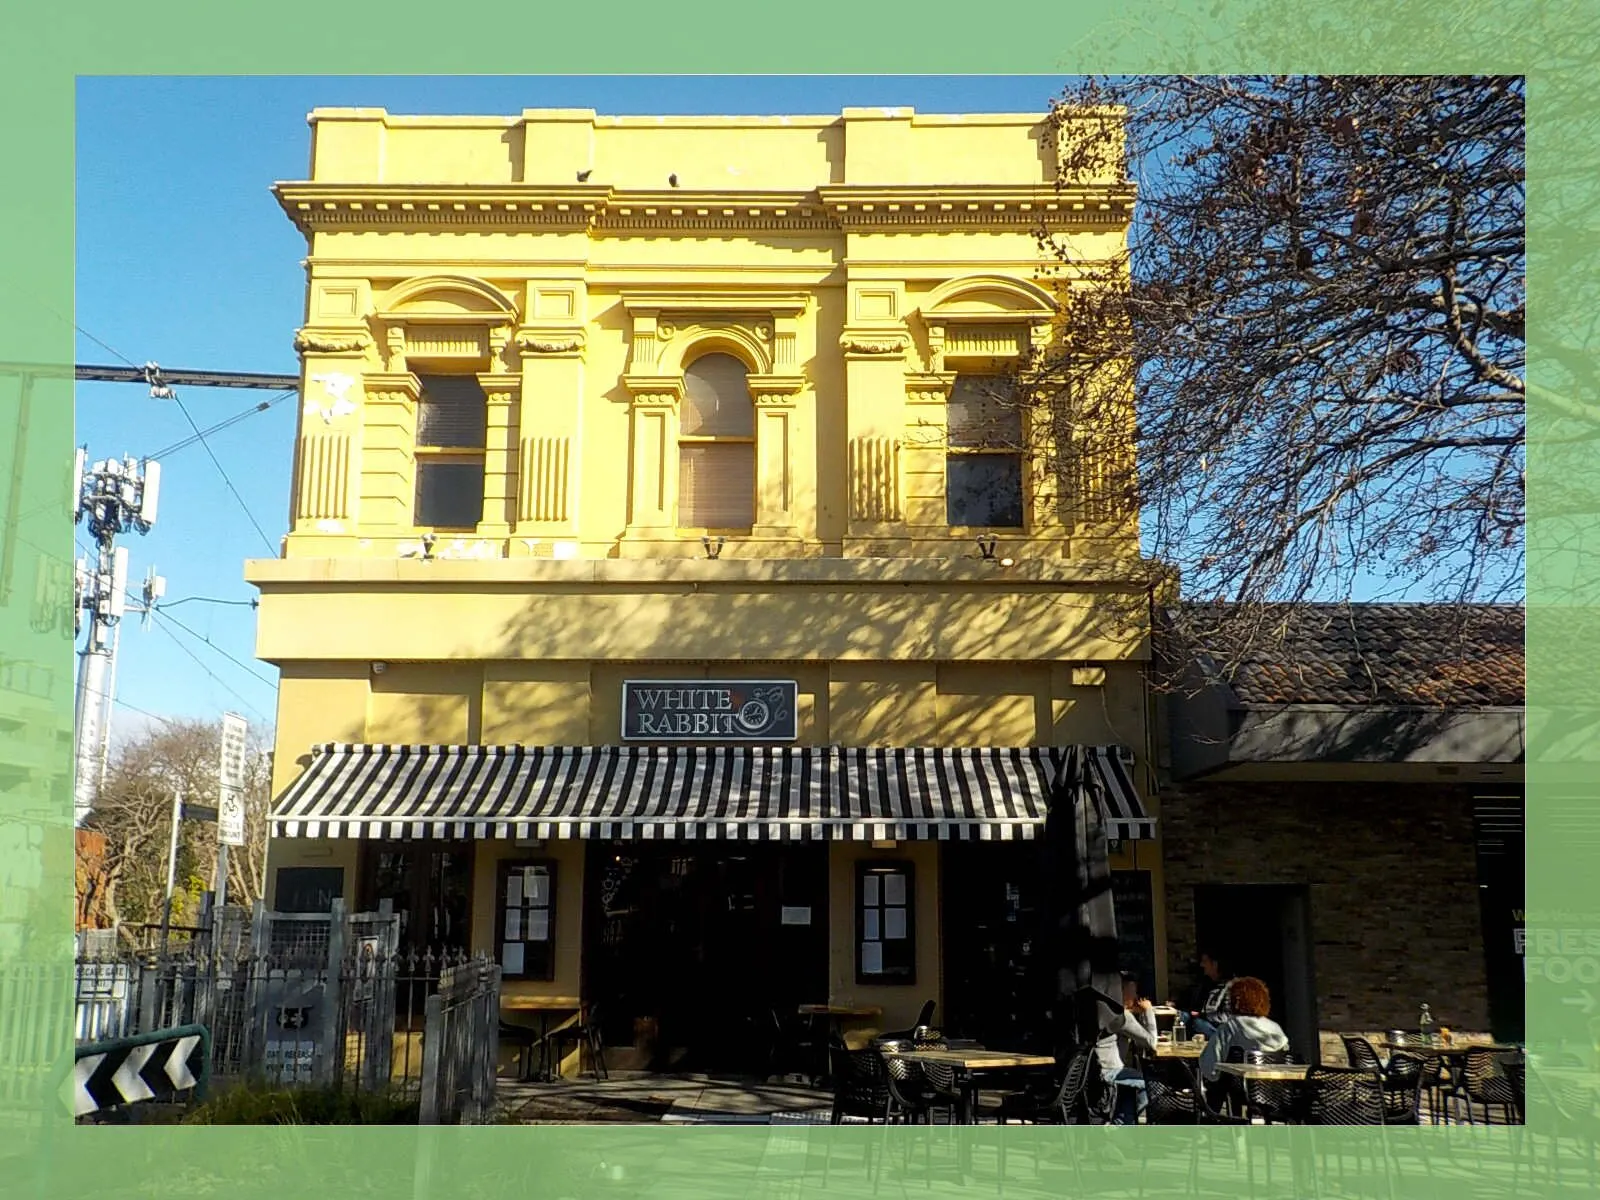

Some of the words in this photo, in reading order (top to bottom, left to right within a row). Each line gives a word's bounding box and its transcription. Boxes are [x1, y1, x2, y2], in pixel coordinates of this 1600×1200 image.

[633, 689, 733, 710] WHITE
[637, 713, 739, 734] RABBIT
[1523, 956, 1600, 983] FOO
